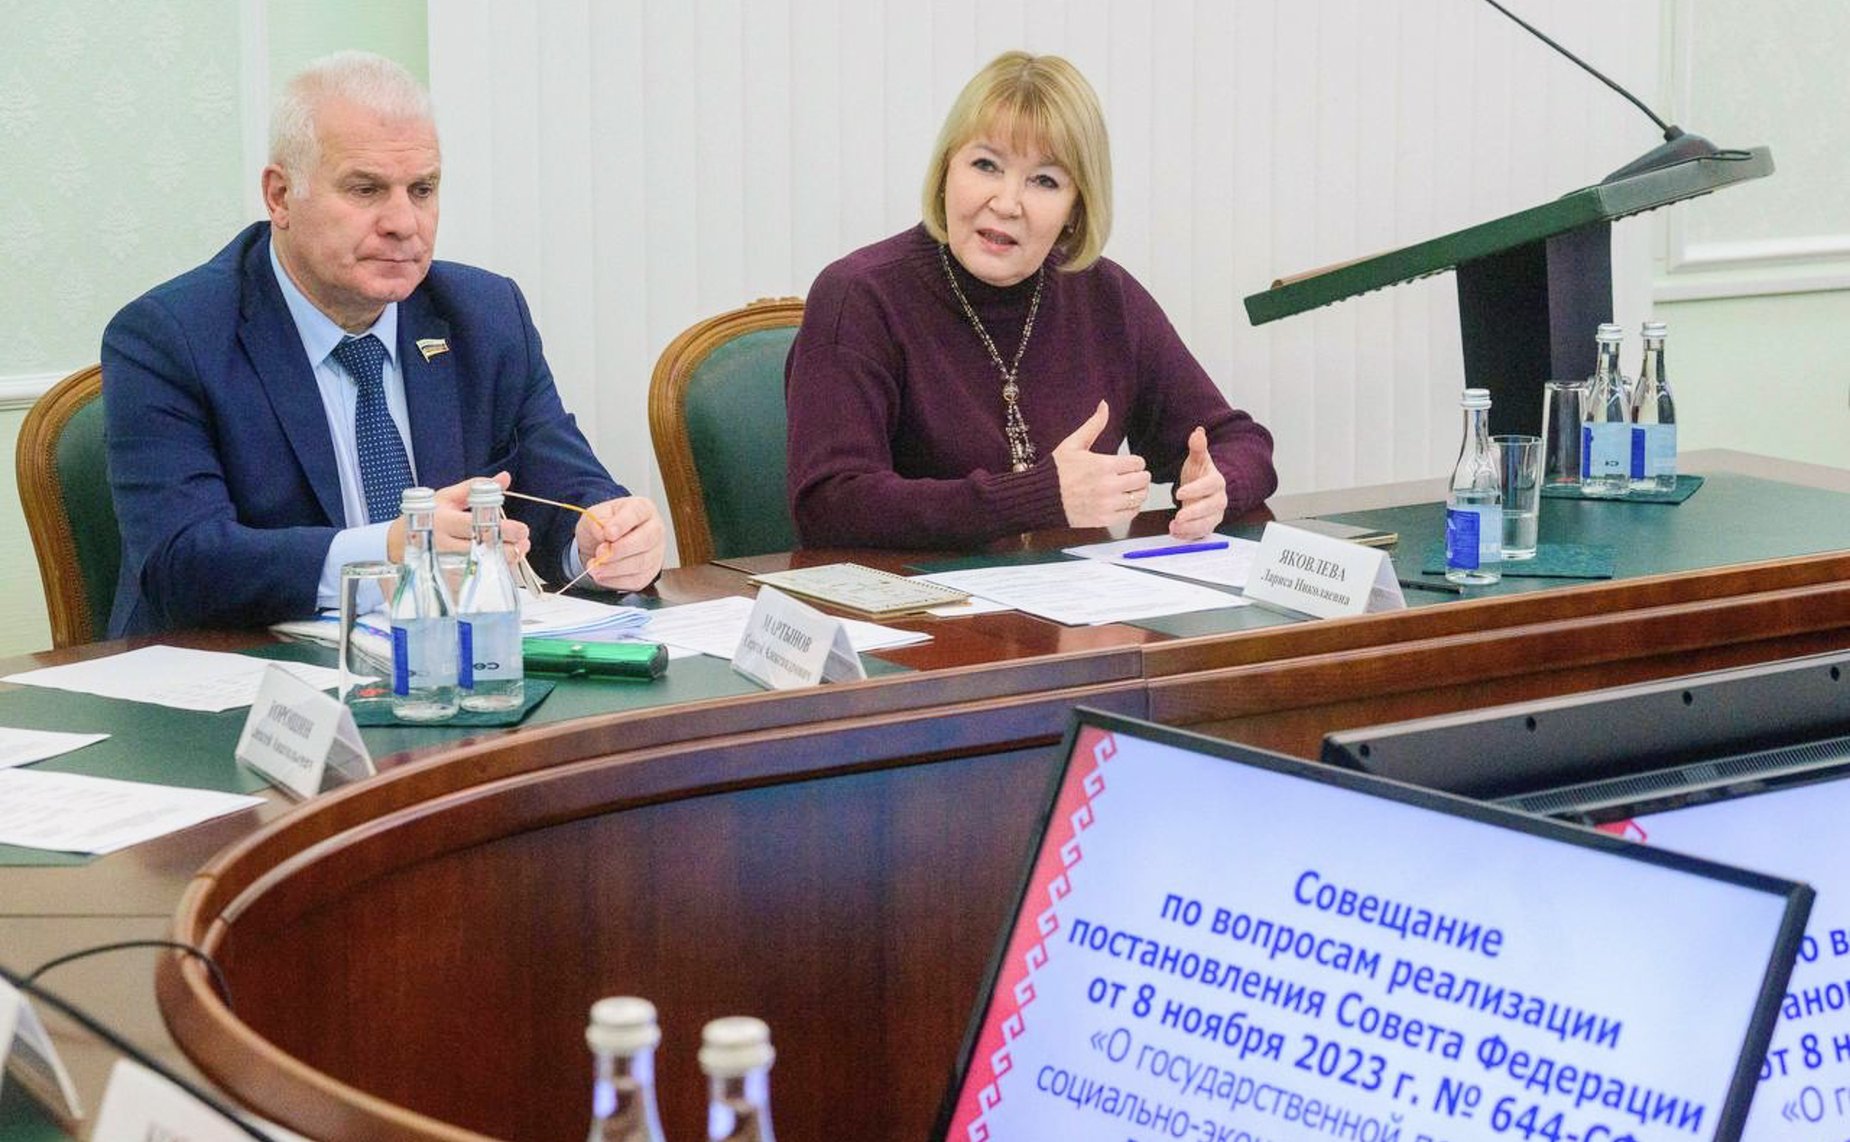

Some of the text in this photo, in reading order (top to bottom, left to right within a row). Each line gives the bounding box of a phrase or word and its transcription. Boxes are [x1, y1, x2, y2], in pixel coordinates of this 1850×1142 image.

[1279, 548, 1346, 582] ЯКОВЛЕВА
[1294, 578, 1351, 606] Николаевна
[1294, 870, 1504, 957] Совещание
[1160, 893, 1623, 1049] по вопросам реализации
[1784, 980, 1850, 1020] ано
[1068, 918, 1706, 1134] постановления Совета Федерации
[1087, 977, 1637, 1142] от 8 ноября 2023 г. № 644-С
[1801, 1034, 1823, 1069] 8
[1037, 1065, 1270, 1142] социально-эк
[1090, 1027, 1404, 1142] «О государственной
[1781, 1086, 1850, 1122] «О г
